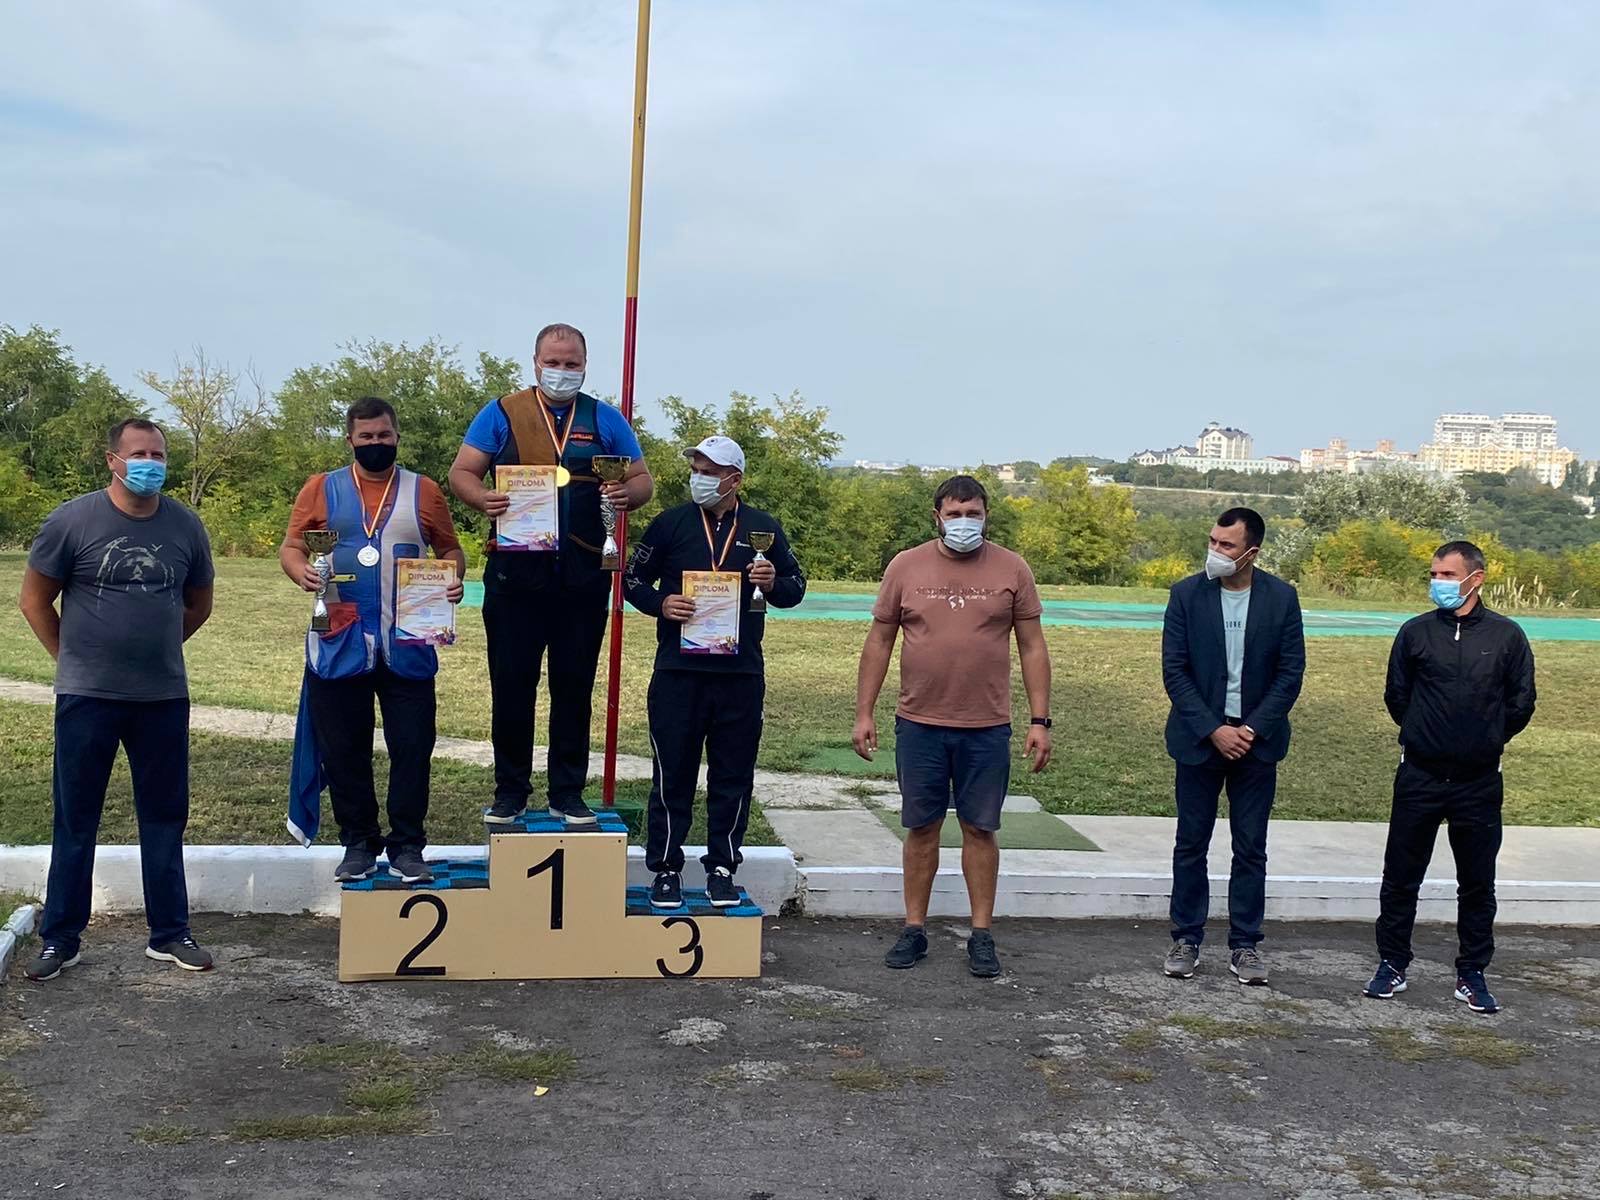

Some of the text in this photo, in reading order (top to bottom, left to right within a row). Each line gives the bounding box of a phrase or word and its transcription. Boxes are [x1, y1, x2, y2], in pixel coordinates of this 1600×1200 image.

[527, 848, 564, 930] 1
[395, 894, 448, 976] 2
[656, 917, 704, 978] 3
